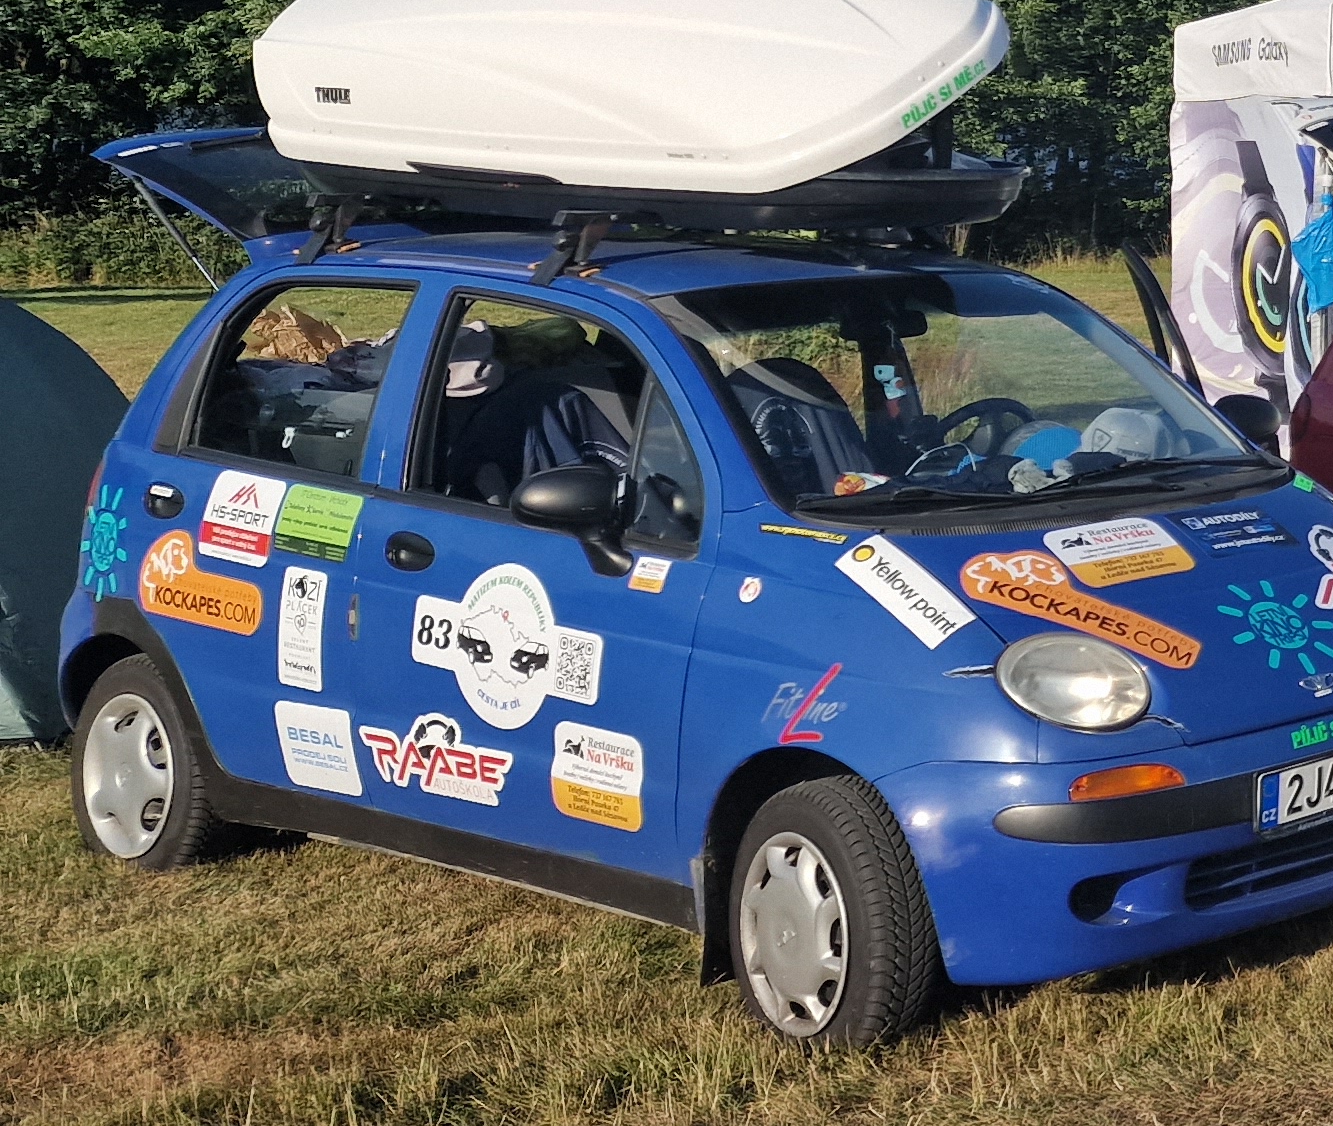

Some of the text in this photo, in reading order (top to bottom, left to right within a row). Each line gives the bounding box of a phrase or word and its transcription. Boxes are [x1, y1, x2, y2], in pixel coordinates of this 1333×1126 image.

[1212, 36, 1289, 67] SAMSUNG Galaxy
[315, 86, 351, 104] THULE
[939, 83, 953, 103] SI
[211, 503, 270, 528] HS-SPORT
[1201, 511, 1260, 527] AUTODÍLY
[1086, 522, 1148, 536] Restaurace
[1092, 529, 1156, 545] Na Vršku
[154, 585, 256, 625] KOCKAPES.COM
[467, 575, 547, 634] MATIZEM KOLEM REPUBLIKY
[870, 555, 957, 636] Yellow point
[417, 614, 453, 650] 83
[988, 580, 1194, 666] KOCKAPES.COM
[476, 688, 499, 710] CESTA
[500, 700, 509, 711] JE
[286, 726, 344, 749] BESAL
[587, 736, 635, 758] Restaurace
[291, 747, 326, 761] PRODEJ
[363, 732, 509, 787] RAABE
[586, 748, 635, 773] Na Vršku
[433, 777, 496, 801] AUTOŠKOLA
[1261, 807, 1277, 824] CZ
